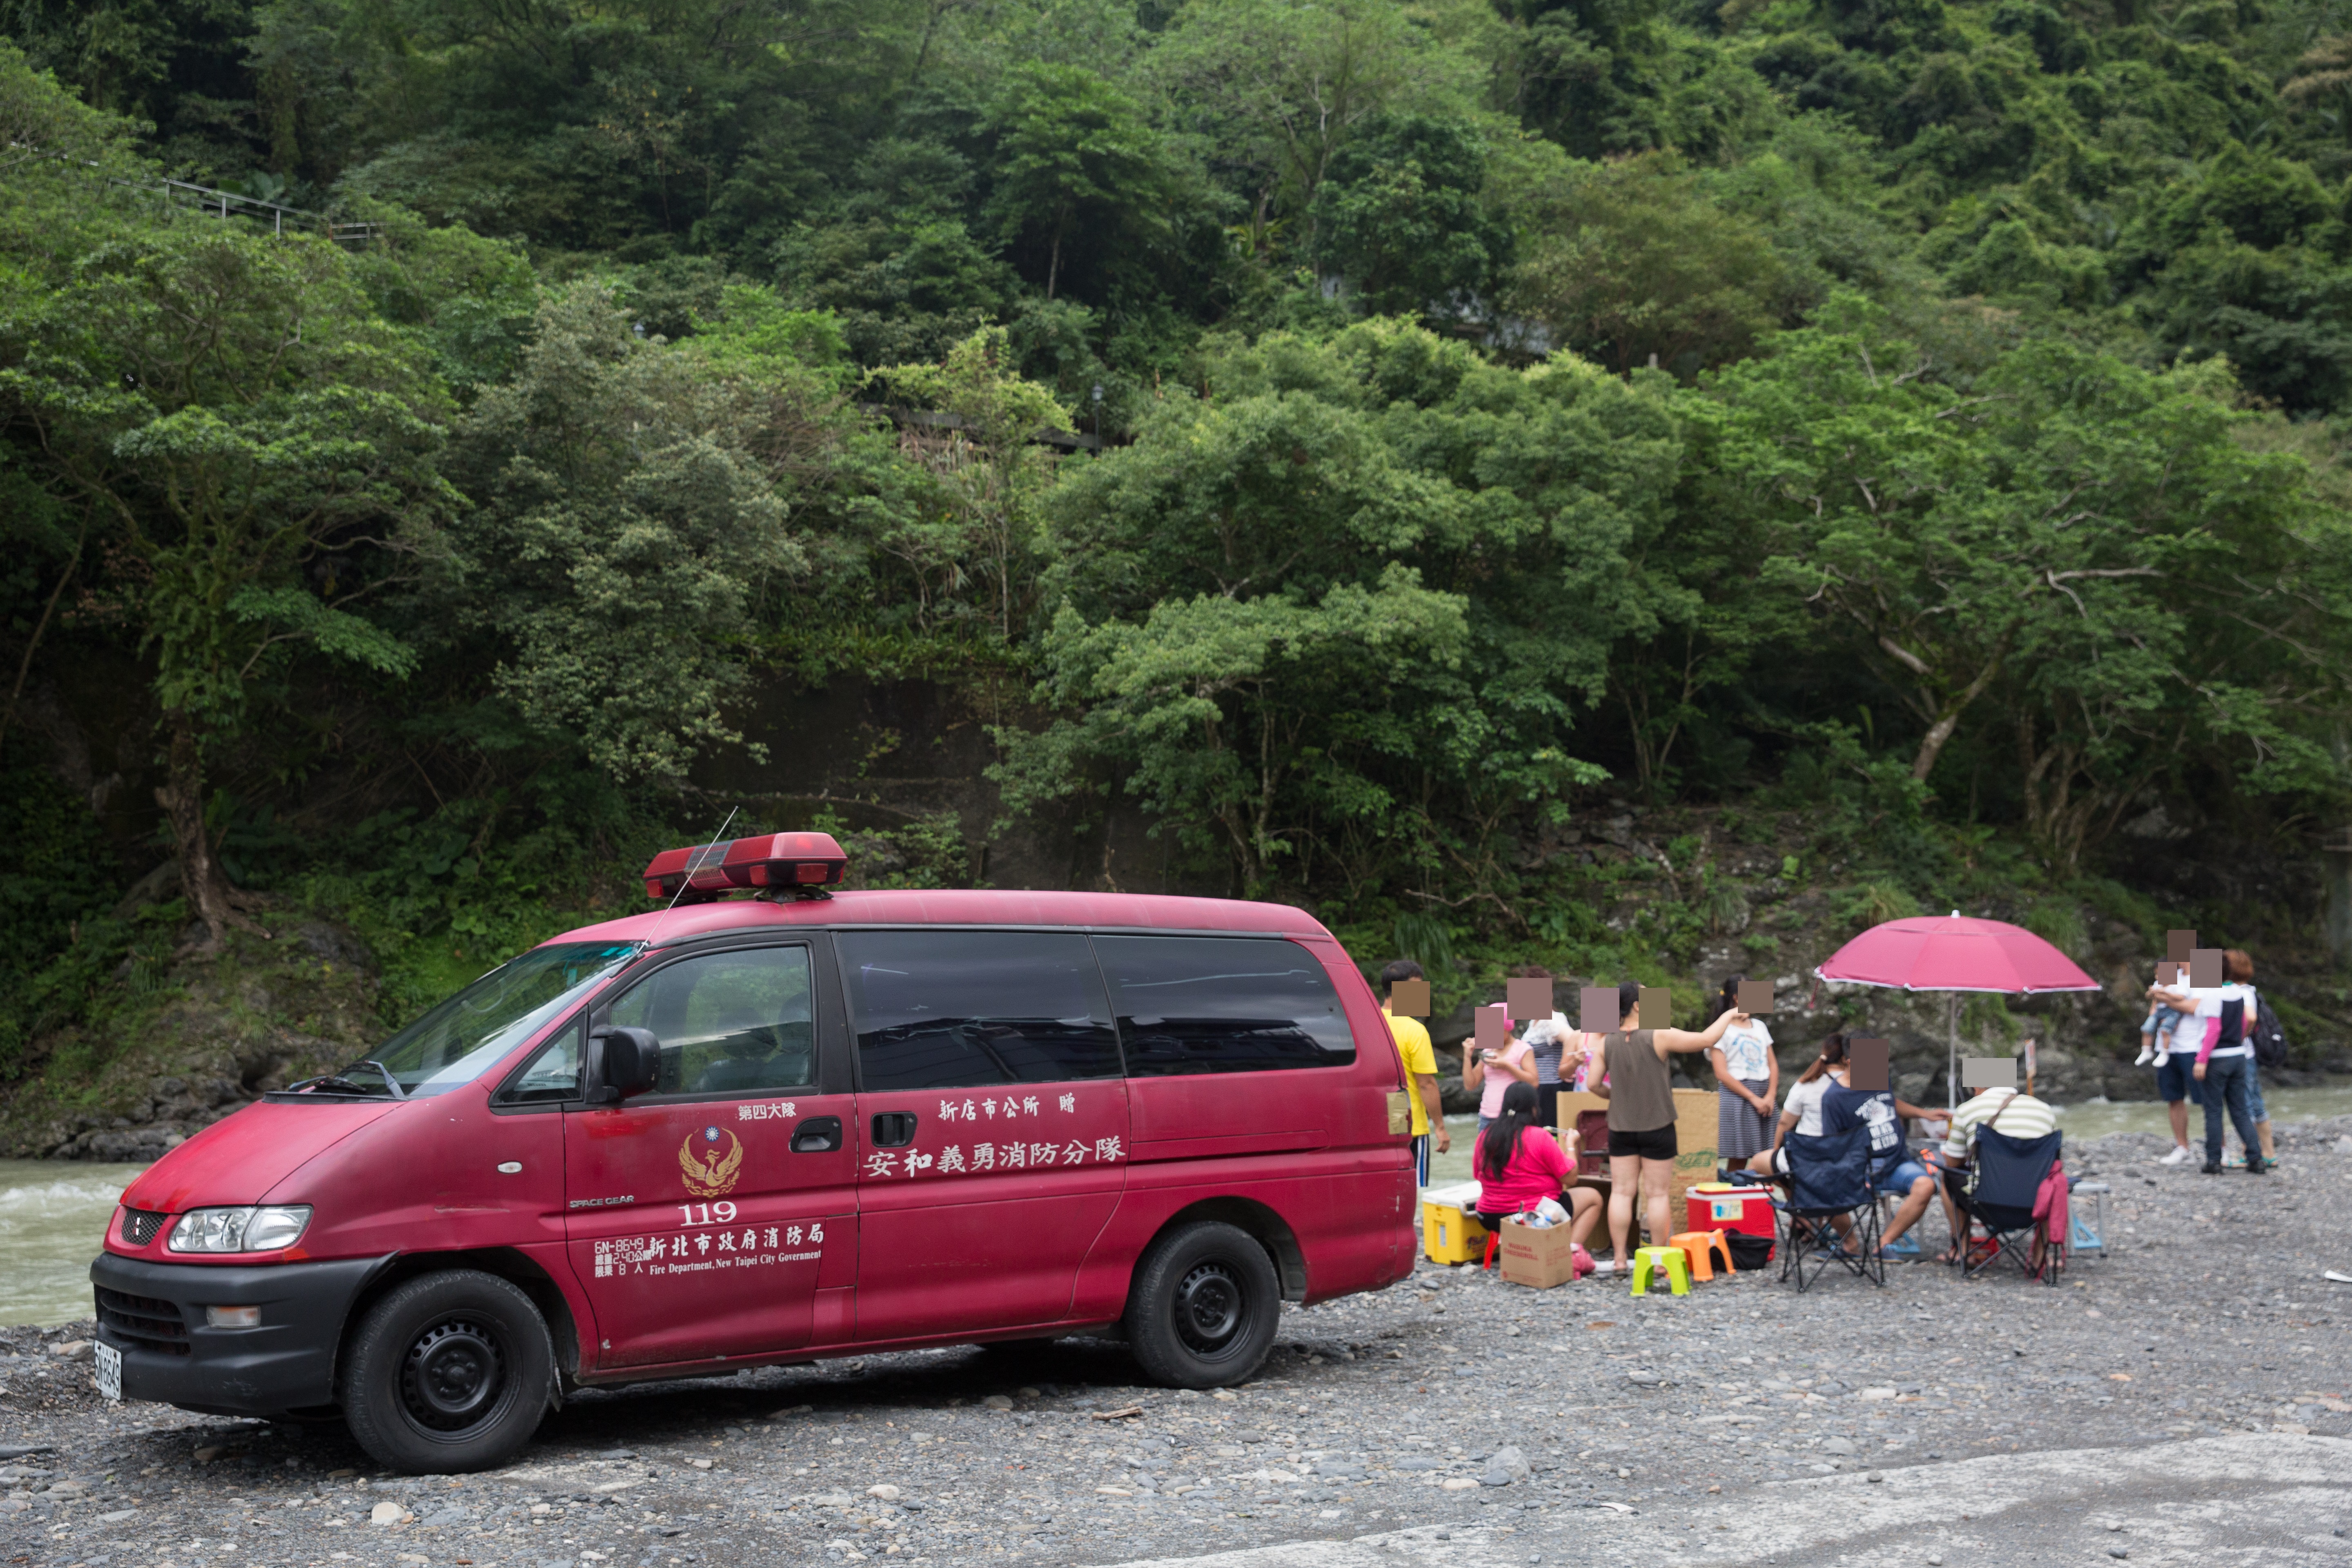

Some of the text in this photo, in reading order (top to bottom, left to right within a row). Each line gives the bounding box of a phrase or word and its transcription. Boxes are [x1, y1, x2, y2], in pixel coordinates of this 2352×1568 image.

[738, 1102, 796, 1121] 第四大隊
[938, 1092, 1076, 1122] 新店市公所 贈
[863, 1135, 1126, 1177] 安和義勇消防分隊
[570, 1195, 634, 1208] SPACE GEAR
[678, 1201, 737, 1226] 119
[595, 1237, 644, 1254] 6N-8649
[650, 1223, 824, 1259] 新北市政府消防局
[619, 1263, 626, 1275] 8
[634, 1262, 643, 1274] 人
[650, 1265, 665, 1275] Fire
[716, 1258, 731, 1268] New
[735, 1255, 757, 1268] Taipei
[760, 1254, 775, 1265] City
[778, 1250, 821, 1262] Government
